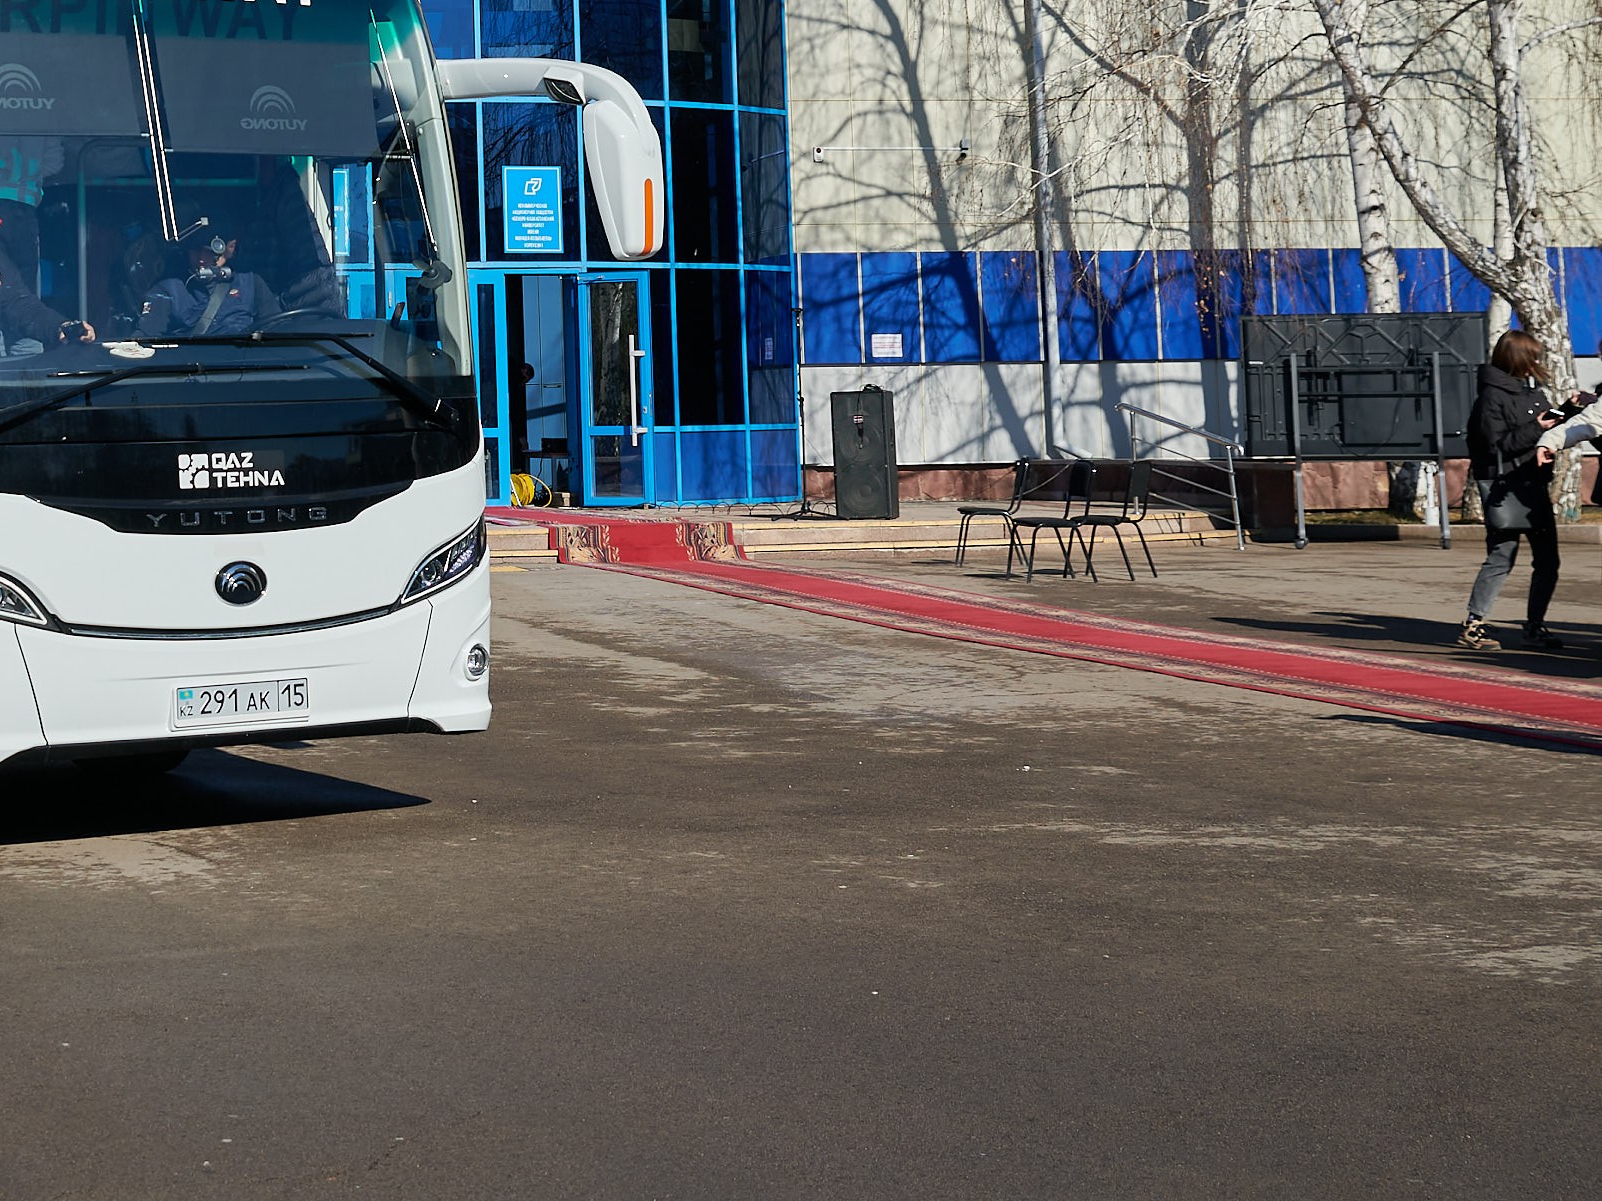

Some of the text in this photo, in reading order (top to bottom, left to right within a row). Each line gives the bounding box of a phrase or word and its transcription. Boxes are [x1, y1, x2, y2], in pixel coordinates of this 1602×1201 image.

[211, 452, 254, 470] QAZ
[212, 469, 285, 488] TEHNA
[146, 506, 327, 527] YUTONG
[200, 683, 304, 714] 291 AK 15
[179, 705, 194, 717] KZ
